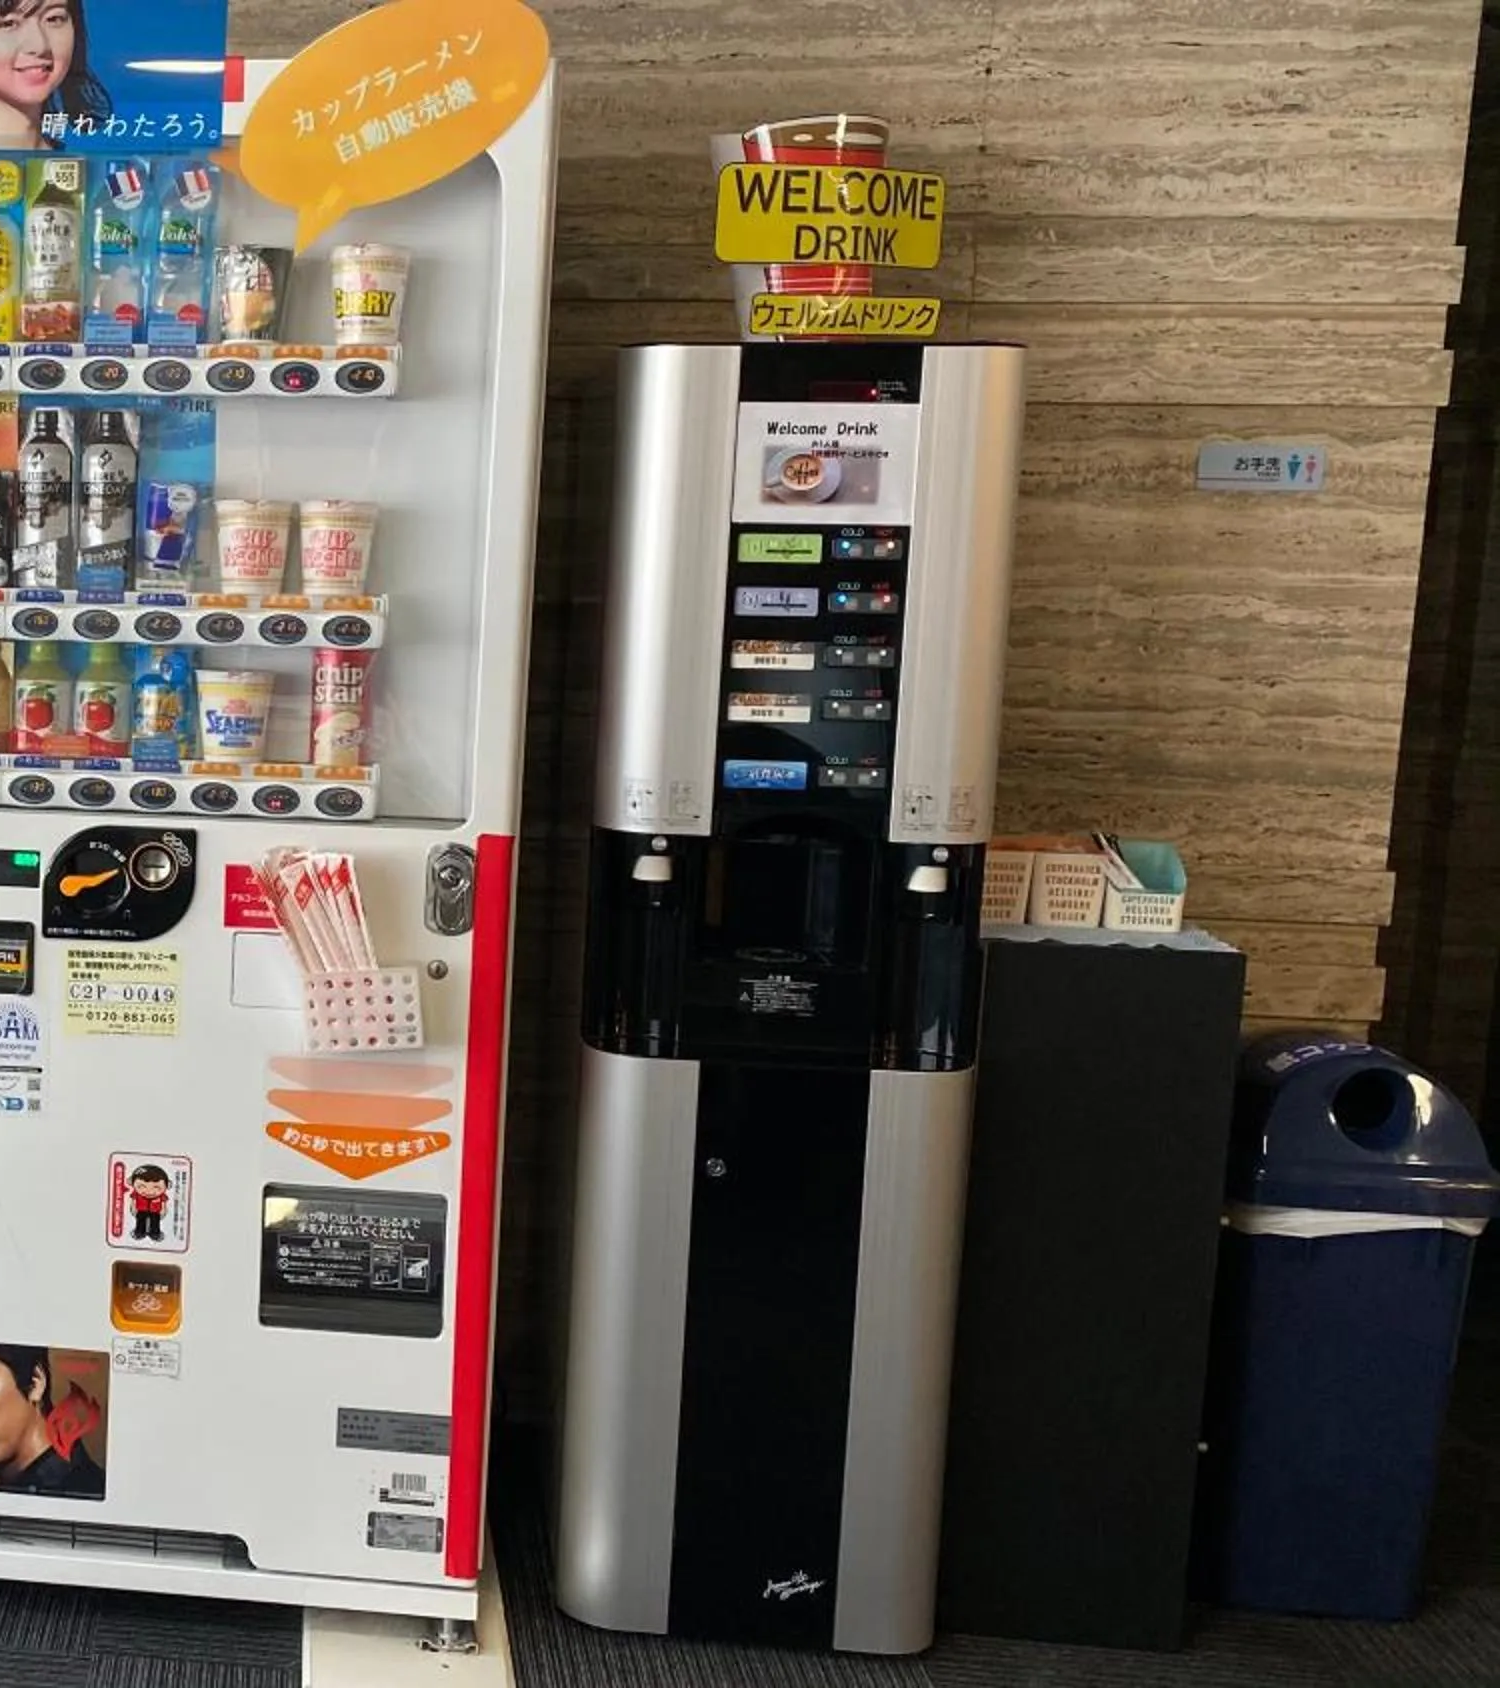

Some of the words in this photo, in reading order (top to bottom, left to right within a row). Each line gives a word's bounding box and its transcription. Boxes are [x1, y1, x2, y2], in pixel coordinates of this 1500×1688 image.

[292, 29, 484, 138] カップラーメン
[41, 112, 219, 140] 晴れわたろう。
[333, 77, 478, 164] 自動販売機
[735, 169, 939, 220] WELCOME
[794, 225, 899, 263] DRINK
[333, 286, 397, 319] CURRY
[753, 301, 935, 330] ウェルカムドリンク
[181, 400, 214, 413] FIRE
[767, 422, 827, 436] Welcome
[838, 422, 879, 436] Drink
